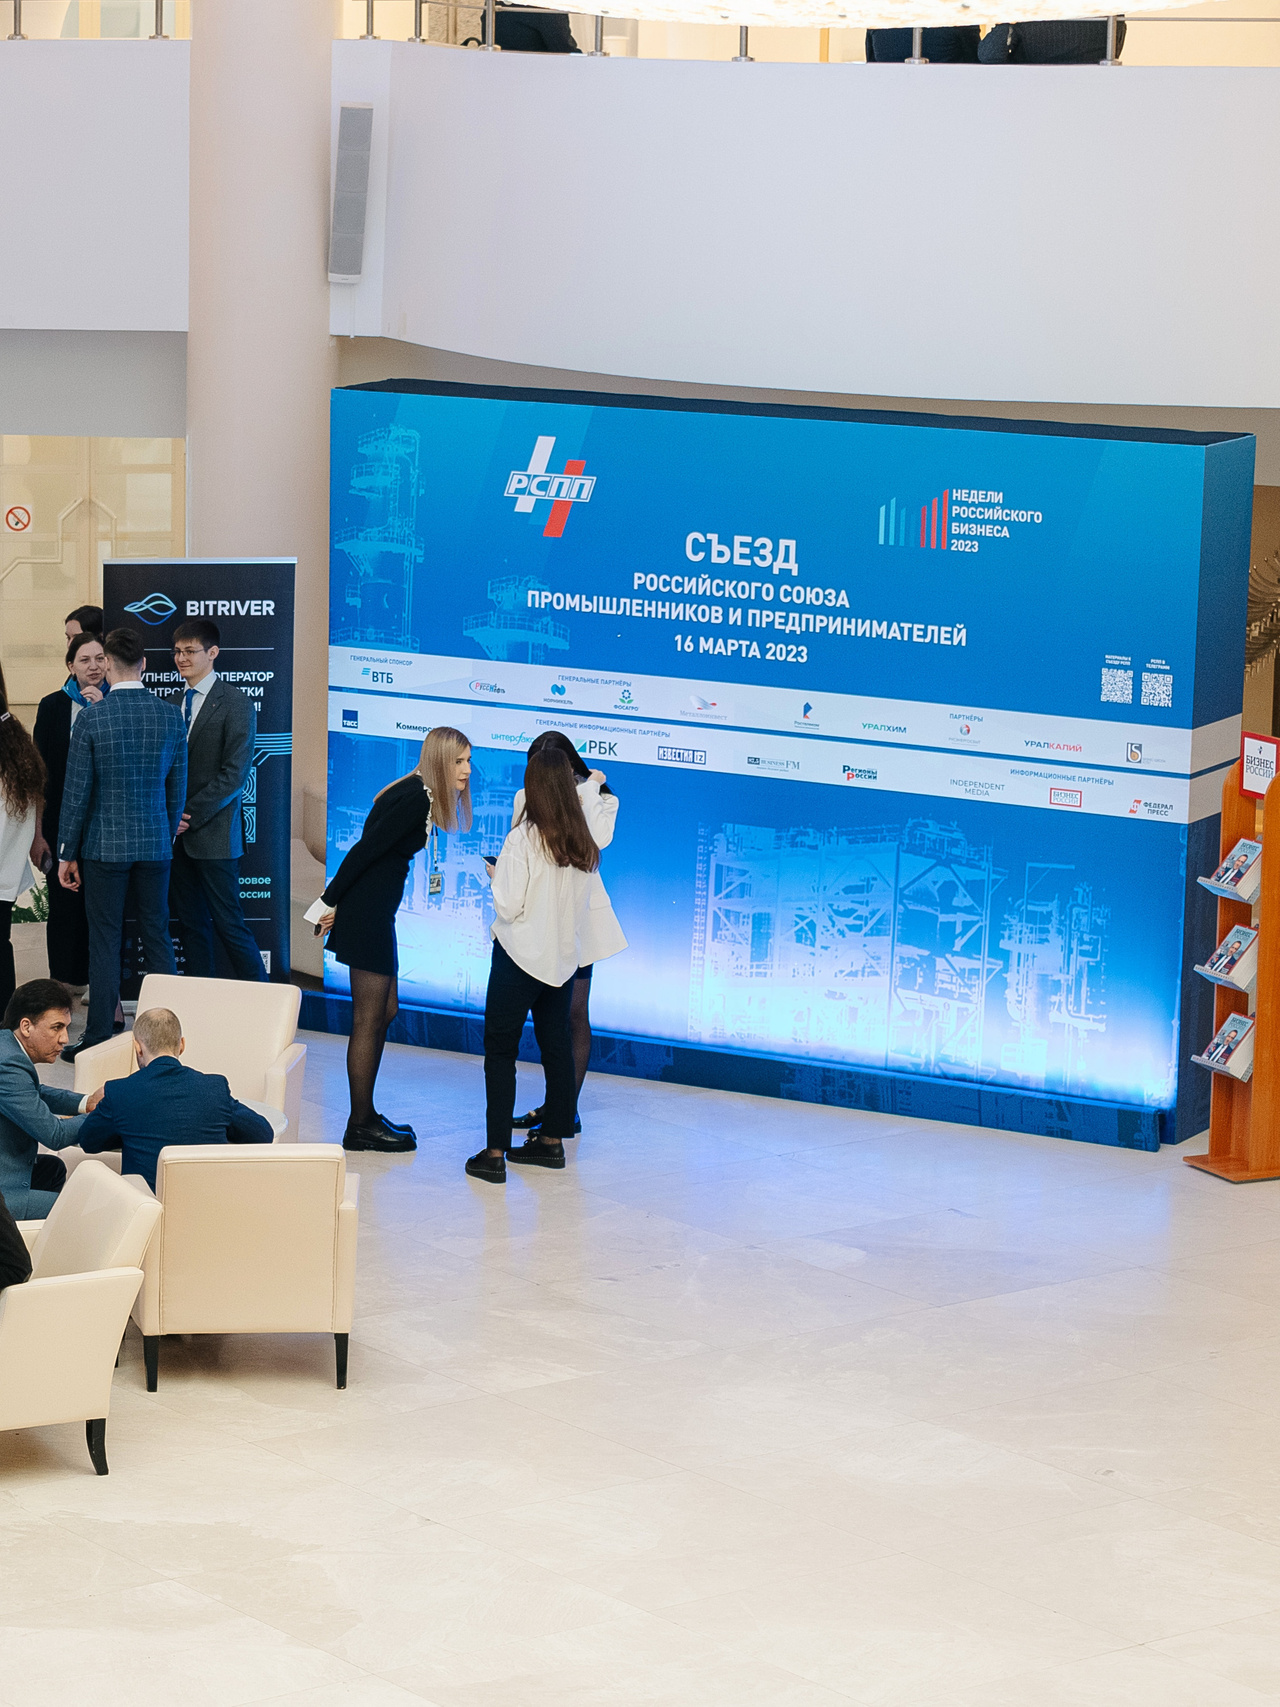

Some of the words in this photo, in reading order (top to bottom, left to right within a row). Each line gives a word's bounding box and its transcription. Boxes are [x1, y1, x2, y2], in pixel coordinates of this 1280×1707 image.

[508, 474, 595, 501] РСПП
[952, 488, 1004, 505] НЕДЕЛИ
[951, 505, 1043, 524] РОССИЙСКОГО
[951, 522, 1010, 539] БИЗНЕСА
[684, 531, 799, 576] СЪЕЗД
[950, 539, 979, 553] 2023
[633, 571, 775, 600] РОССИЙСКОГО
[779, 584, 850, 609] СОЮЗА
[186, 600, 275, 617] BITRIVER
[527, 589, 723, 624] ПРОМЫШЛЕННИКОВ
[728, 607, 743, 626] И
[748, 608, 967, 647] ПРЕДПРИНИМАТЕЛЕЙ
[674, 634, 695, 653] 16
[699, 636, 761, 659] МАРТА
[765, 641, 809, 664] 2023
[350, 655, 388, 664] ГЕНЕРАЛЬНЫЙ
[389, 659, 413, 667] СПОНСОР
[372, 671, 394, 684] ВТБ
[558, 674, 600, 685] ГЕНЕРАЛЬНЫЕ
[600, 678, 632, 687] ПАРТНЁРЫ
[613, 704, 639, 712] ФОСАГРО
[949, 713, 984, 722] ПАРТНЁРЫ
[535, 718, 578, 729] ГЕНЕРАЛЬНЫЕ
[579, 721, 637, 735] ИНФОРМАЦИОННЫЕ
[638, 728, 671, 738] ПАРТНЁРЫ
[861, 722, 907, 734] УРАЛХИМ
[588, 739, 618, 757] РБК
[1024, 739, 1082, 753] УРАЛКАЛИЙ
[658, 747, 693, 763] ИЗВЕСТИЯ
[1246, 754, 1274, 770] БИЗНЕС
[786, 760, 800, 770] FM
[1245, 764, 1274, 779] РОССИИ
[950, 778, 1005, 791] INDEPENDENT
[1010, 768, 1077, 782] ИНФОРМАЦИОННЫЕ
[1077, 774, 1115, 786] ПАРТНЁРЫ
[964, 787, 990, 797] MEDIA
[1143, 801, 1174, 811] ФЕДЕРАЛ
[1147, 808, 1169, 817] ПРЕСС
[239, 891, 271, 899] оссии
